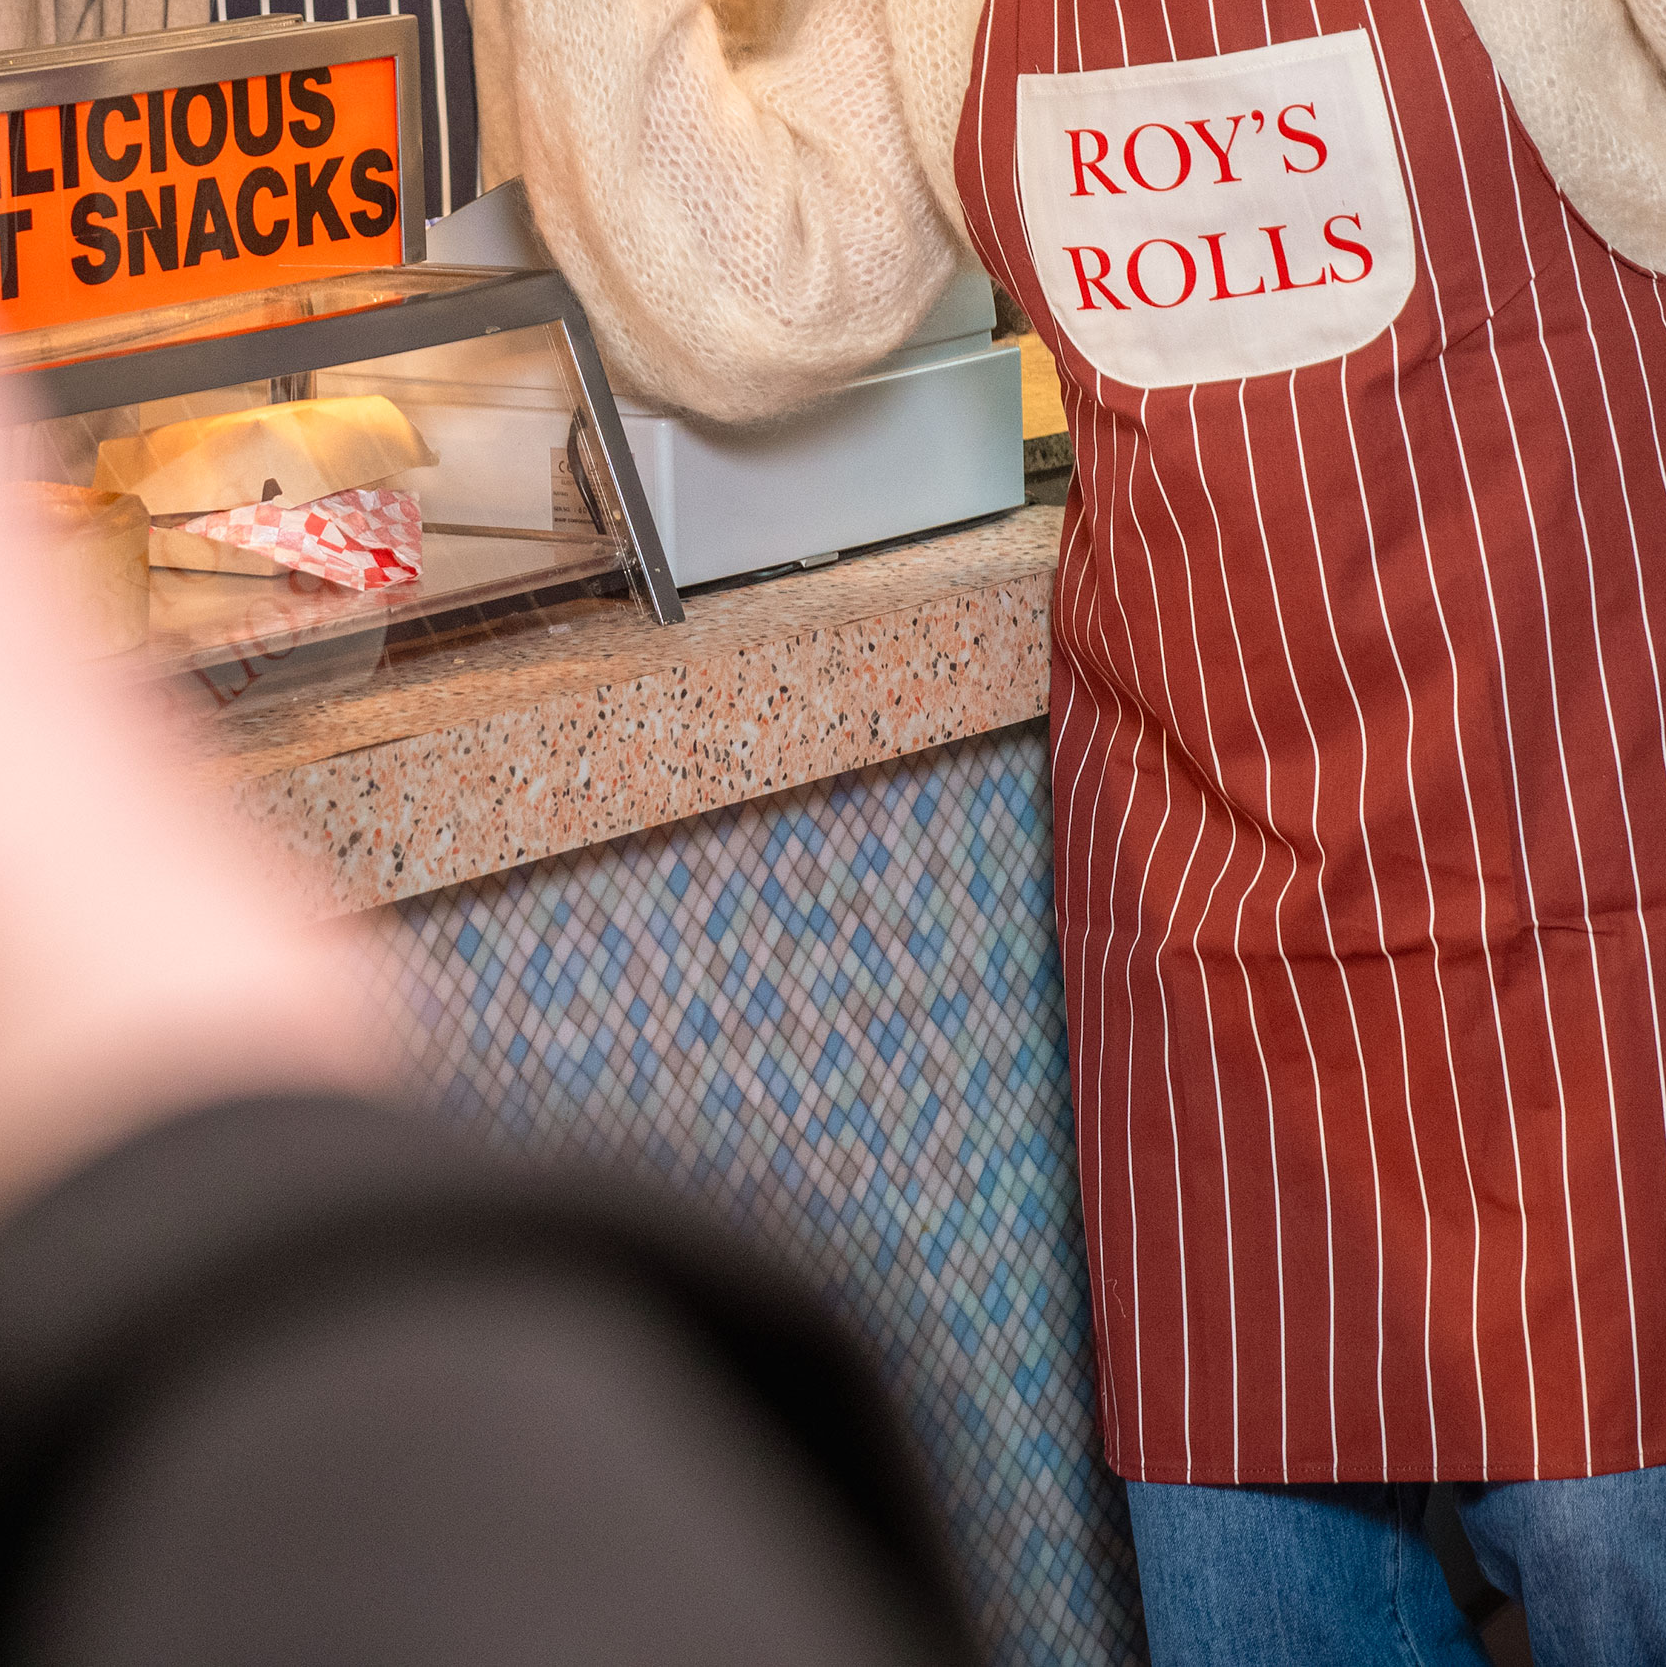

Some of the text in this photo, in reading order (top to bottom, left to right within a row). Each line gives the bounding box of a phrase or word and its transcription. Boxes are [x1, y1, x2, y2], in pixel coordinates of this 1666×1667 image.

[1065, 101, 1328, 197] ROY'S
[70, 148, 397, 286] SNACKS
[1062, 212, 1374, 311] ROLLS
